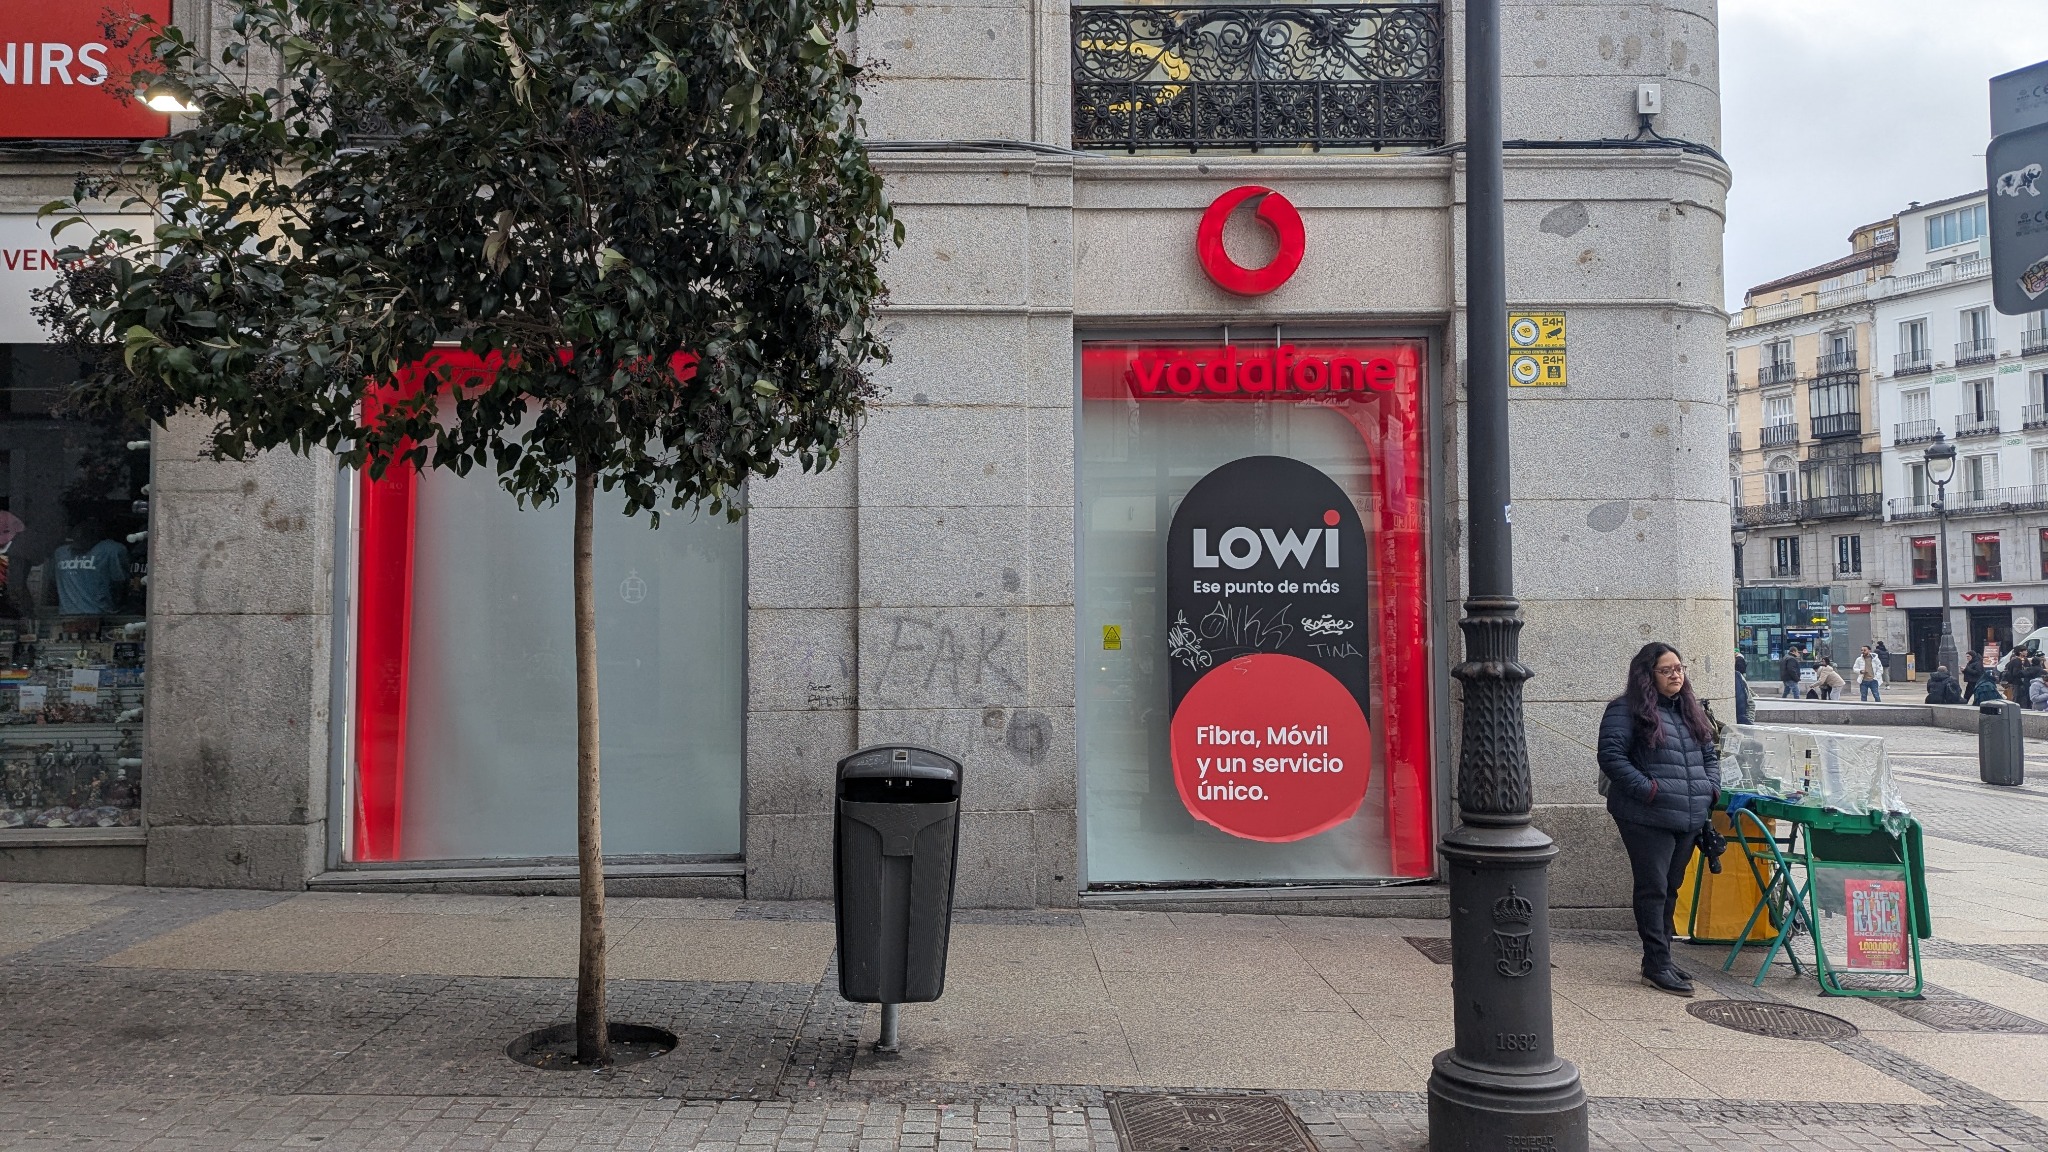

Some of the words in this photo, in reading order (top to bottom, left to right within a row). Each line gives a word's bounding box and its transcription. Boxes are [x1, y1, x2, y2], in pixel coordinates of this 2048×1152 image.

[1542, 318, 1564, 326] 24H
[1131, 345, 1397, 393] vodafone
[1543, 356, 1564, 364] 24H
[1193, 580, 1221, 593] Ese
[1225, 581, 1274, 598] punto
[1278, 580, 1299, 593] de
[1303, 579, 1340, 593] más
[1960, 592, 2013, 602] VIPS
[1307, 641, 1363, 658] TINA
[1197, 725, 1261, 748] Fibra,
[1267, 724, 1328, 745] Móvil
[1197, 758, 1211, 778] y
[1217, 757, 1246, 772] un
[1252, 753, 1344, 773] servicio
[1197, 780, 1269, 800] único.
[1853, 890, 1900, 900] QUIEN
[1853, 899, 1901, 933] RASCA
[1497, 1033, 1538, 1051] 1832
